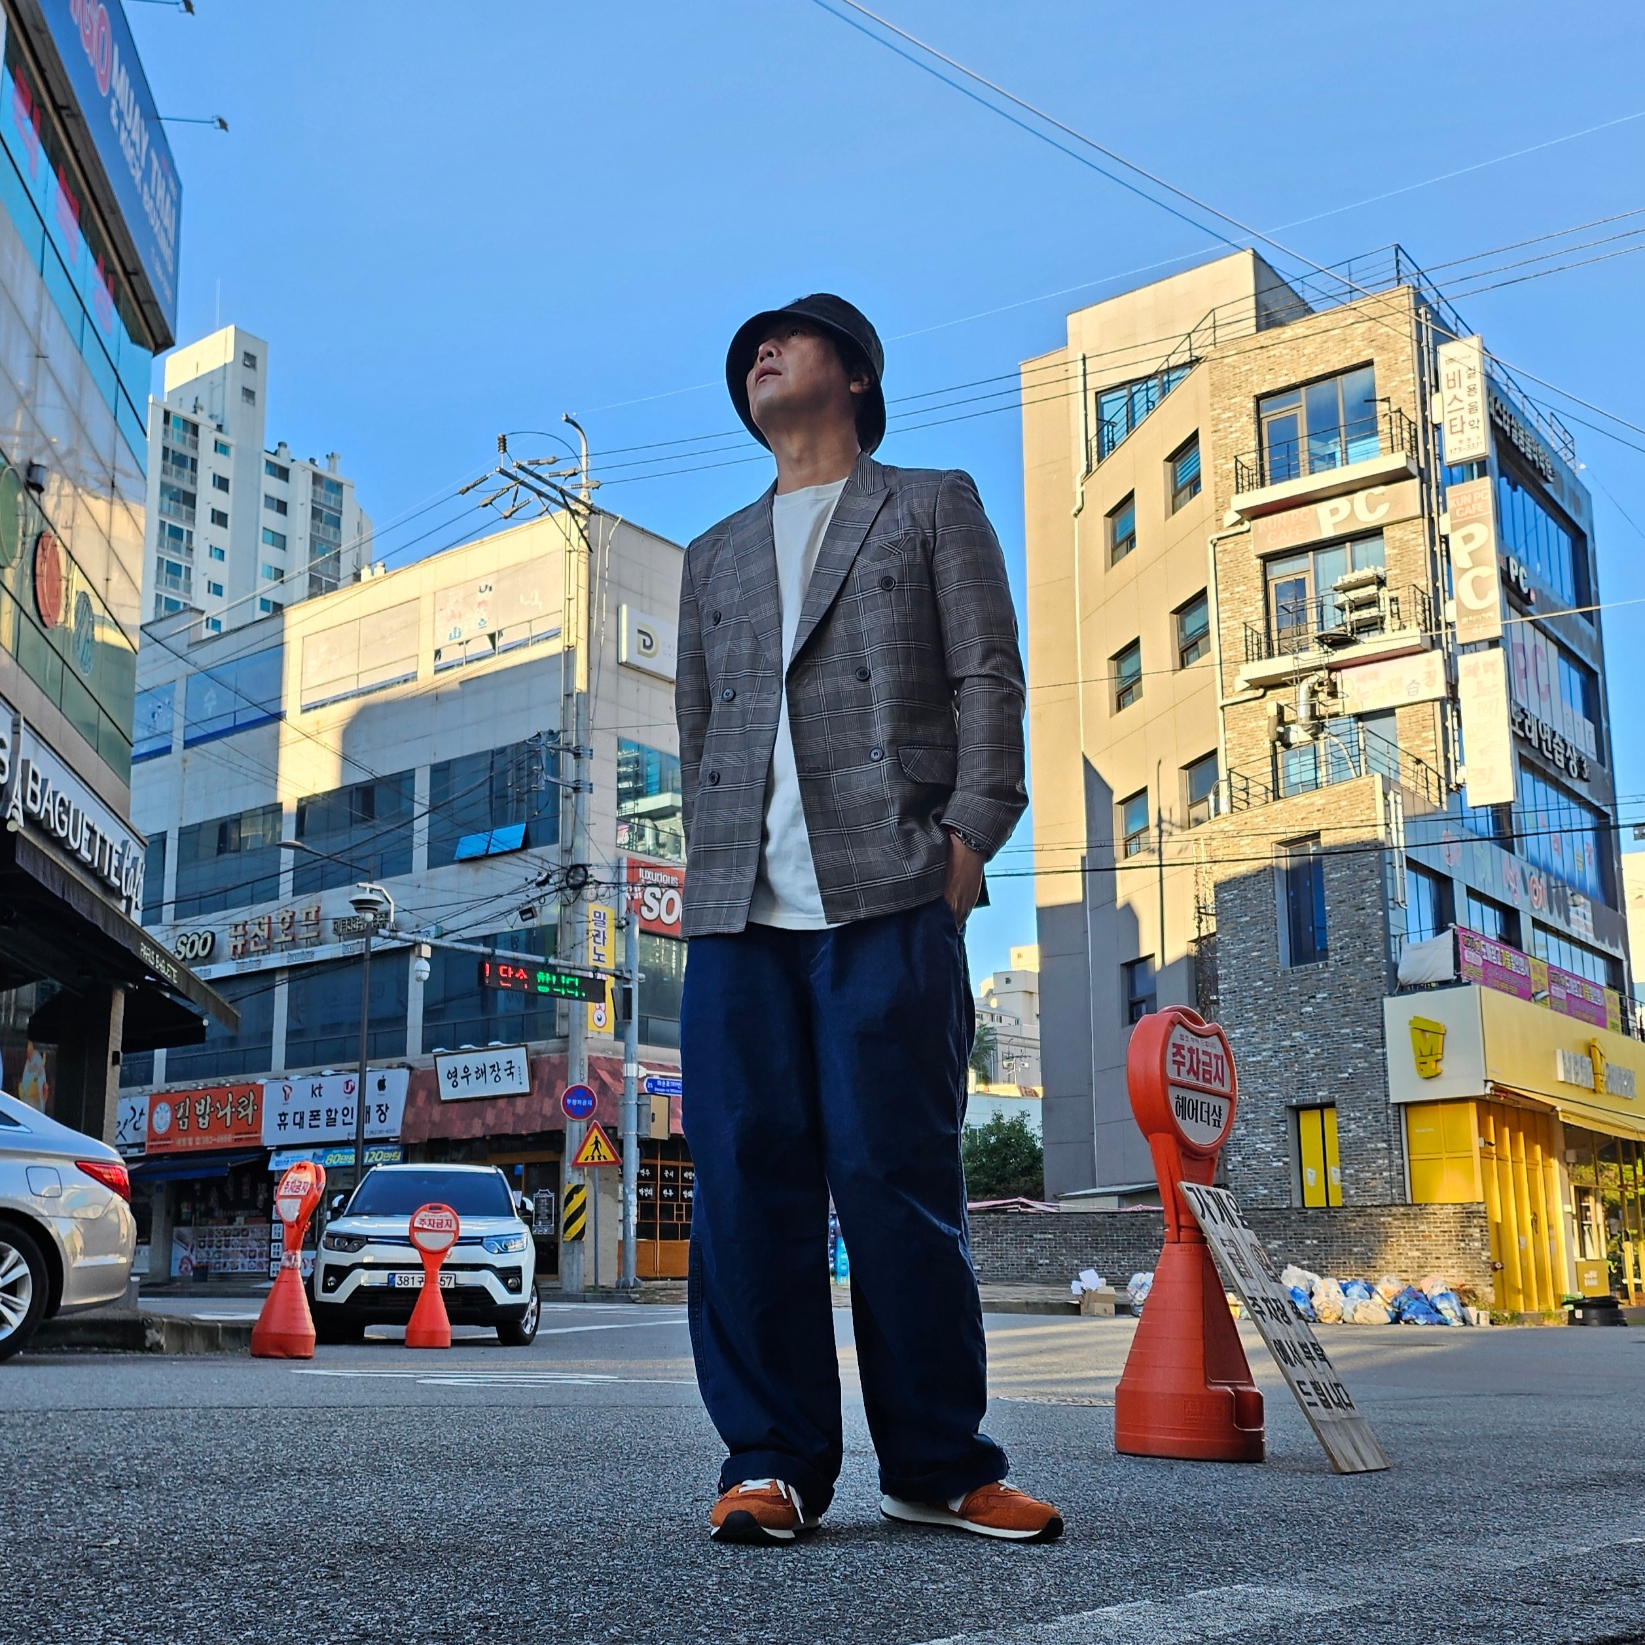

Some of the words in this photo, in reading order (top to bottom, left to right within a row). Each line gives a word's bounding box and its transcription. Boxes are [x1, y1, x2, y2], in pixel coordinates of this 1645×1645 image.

[111, 41, 150, 169] MUAY
[150, 146, 176, 248] THAI
[1446, 368, 1466, 436] 비스타
[1290, 508, 1311, 523] PC
[1316, 485, 1391, 538] PC
[1450, 493, 1473, 509] KUN
[1473, 490, 1489, 503] PC
[1456, 502, 1485, 518] CAFE
[1267, 524, 1304, 544] CAFE
[1450, 521, 1499, 611] PC
[1507, 555, 1529, 595] PC
[1511, 699, 1578, 779] 노래연습장
[21, 758, 123, 888] BAGUETTE
[639, 867, 679, 888] luxurious
[641, 886, 684, 925] SO
[174, 930, 212, 962] SOO
[228, 904, 321, 959] 퓨전호프
[499, 965, 529, 990] 단속
[446, 1059, 516, 1089] 영우해장국
[1172, 1042, 1226, 1088] 주차금지
[311, 1083, 323, 1098] kt
[174, 1089, 259, 1132] 김밥나라
[1174, 1094, 1223, 1129] 헤어더샵
[284, 1179, 311, 1194] 주차금지
[1296, 1380, 1356, 1412] 드립니다
